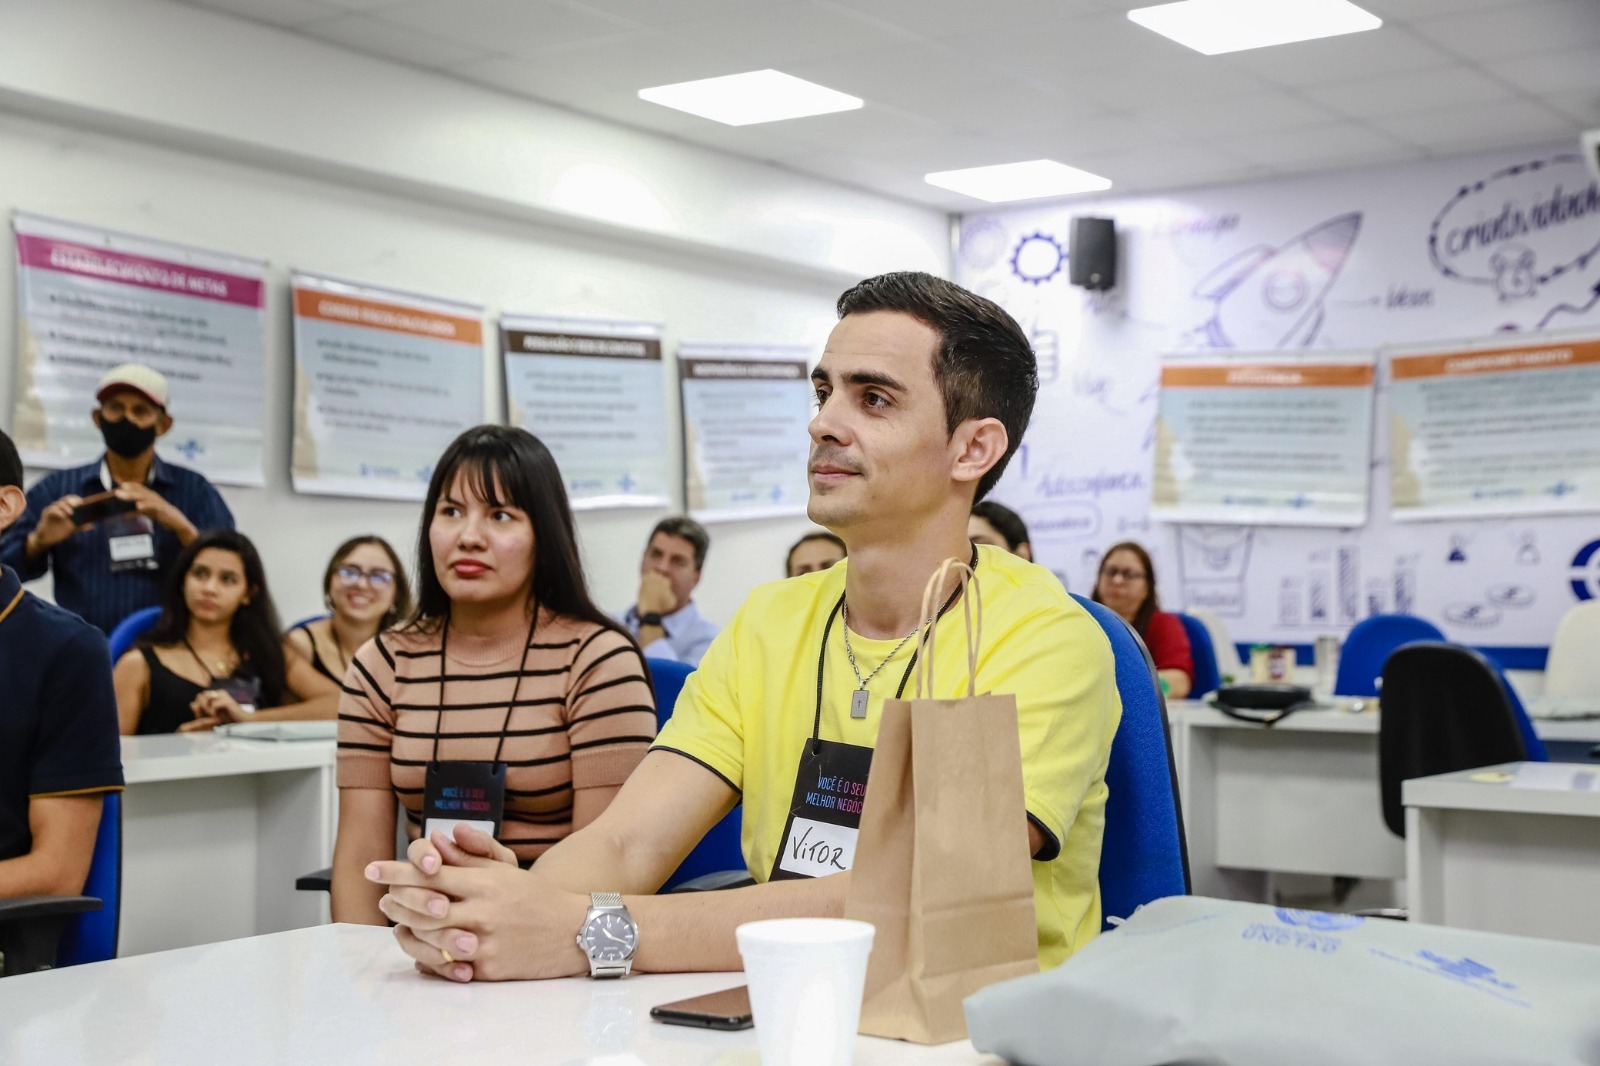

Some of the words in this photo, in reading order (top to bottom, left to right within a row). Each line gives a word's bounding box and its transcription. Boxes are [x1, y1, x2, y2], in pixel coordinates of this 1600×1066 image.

[817, 775, 837, 791] VOCÊ
[837, 776, 844, 792] É
[844, 782, 850, 793] O
[850, 781, 867, 797] SEU
[805, 791, 836, 808] MELHOR
[837, 796, 864, 813] NEGÓC
